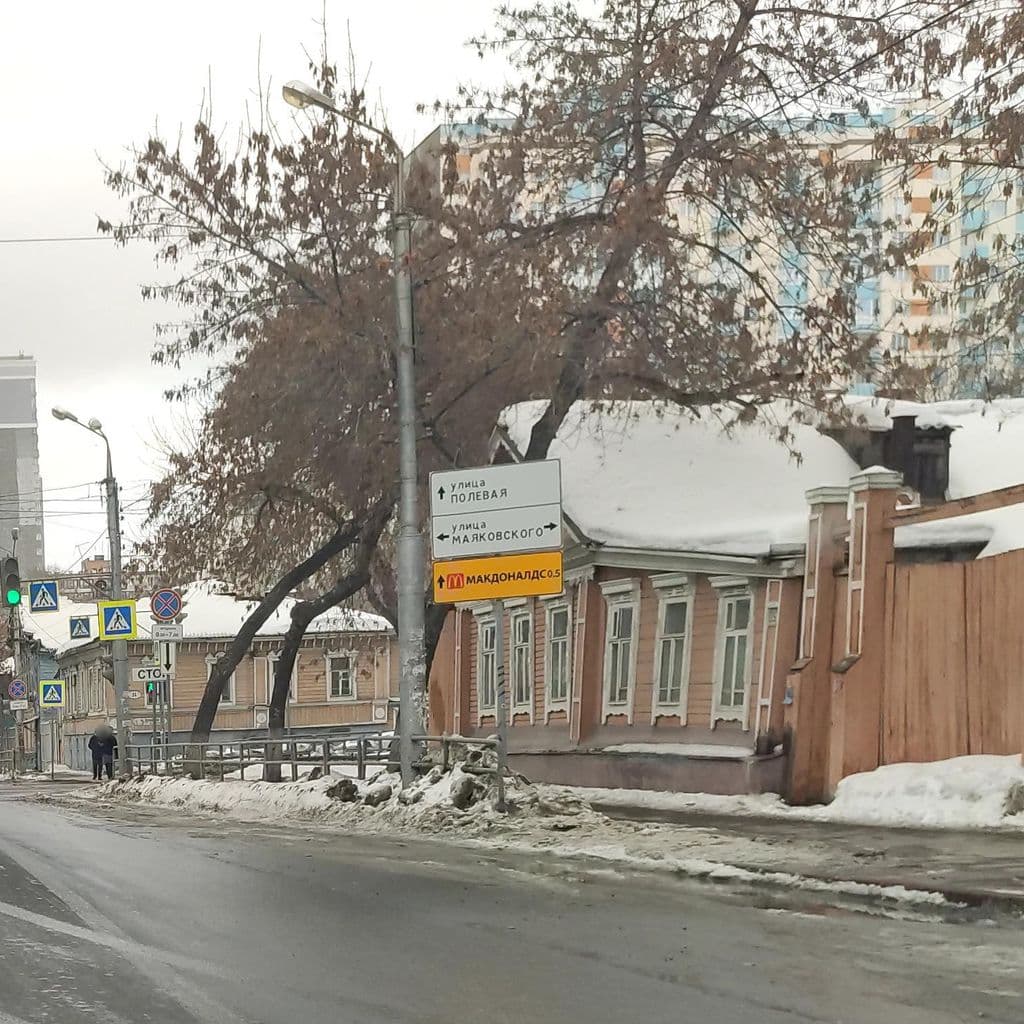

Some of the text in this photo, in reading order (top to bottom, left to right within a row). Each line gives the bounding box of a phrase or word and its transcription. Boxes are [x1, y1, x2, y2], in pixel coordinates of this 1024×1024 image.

[451, 479, 485, 491] улица
[451, 489, 508, 503] ПОЛЕВАЯ
[452, 520, 487, 533] улица
[452, 527, 543, 545] МАЯКОВСКОГО
[466, 569, 547, 585] МАКДОНАЛДС
